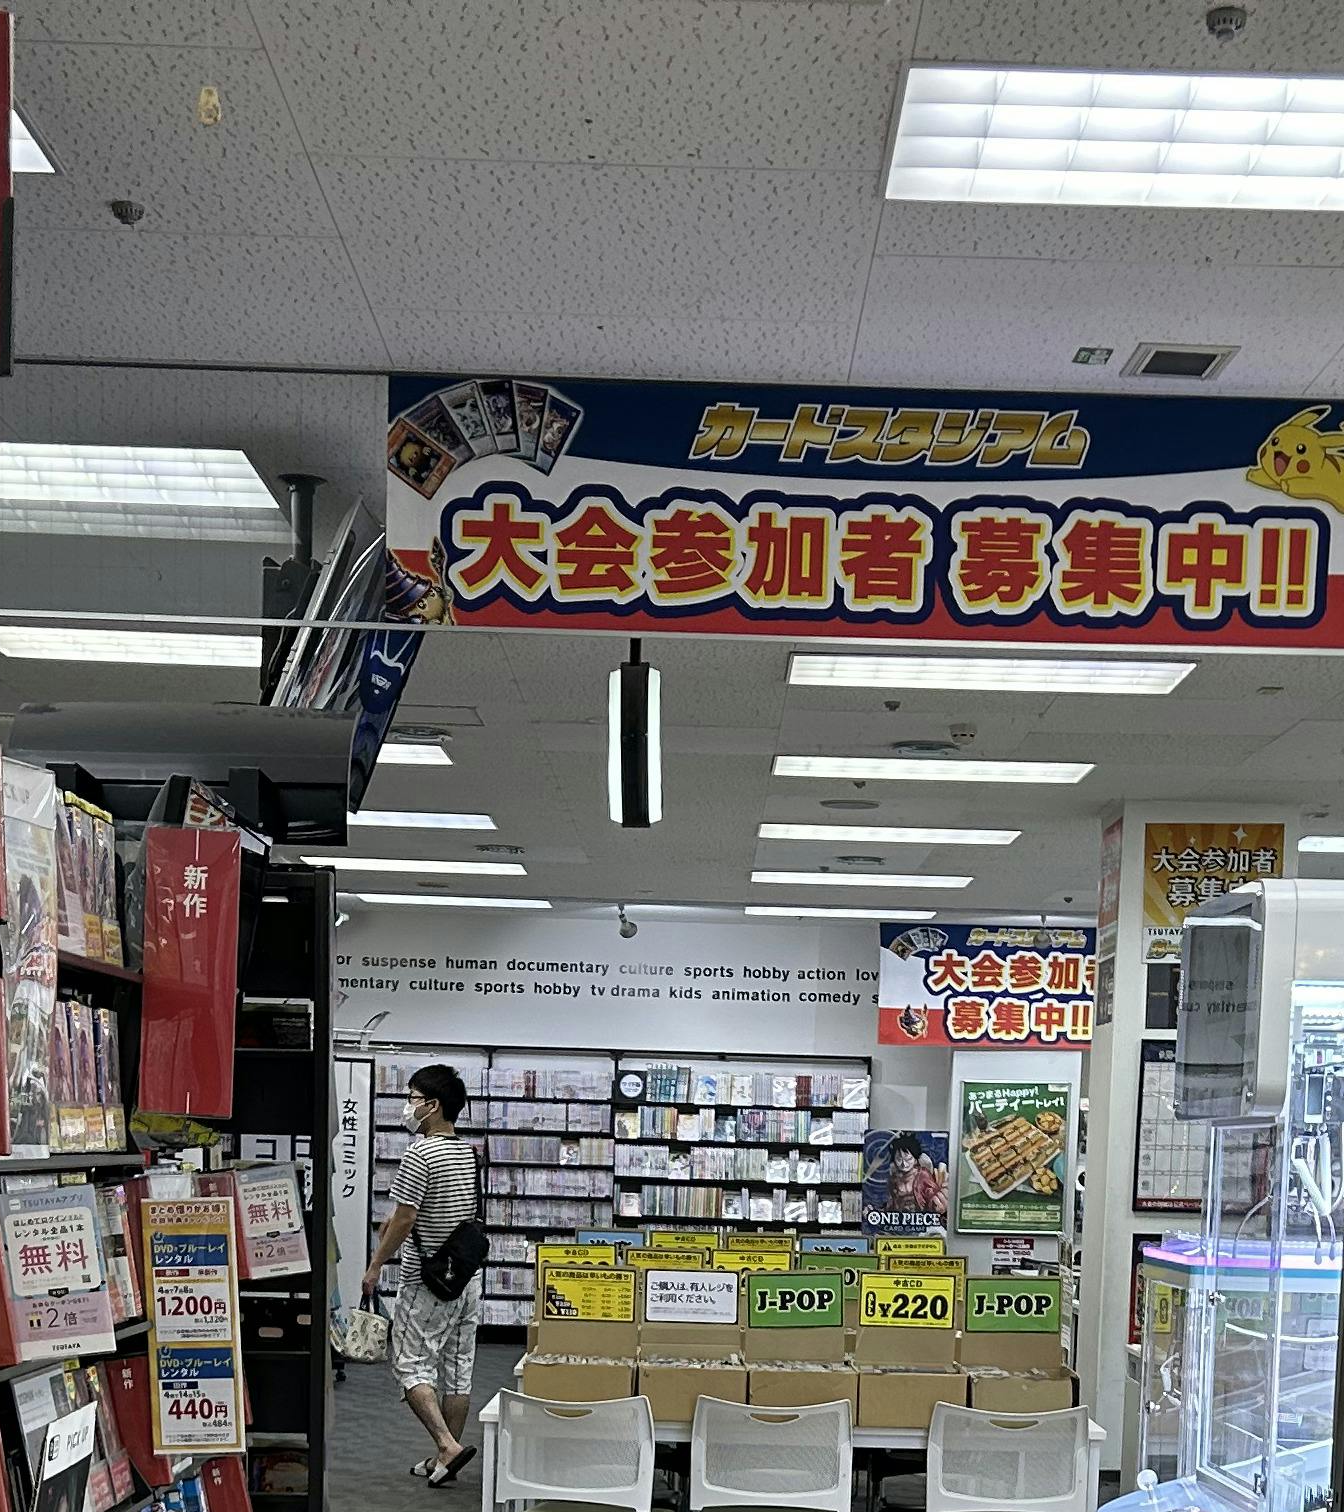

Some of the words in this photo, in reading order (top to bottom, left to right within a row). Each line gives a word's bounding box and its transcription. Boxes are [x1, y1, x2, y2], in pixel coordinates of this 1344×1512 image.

[689, 404, 1092, 469] カードスタジアム
[459, 501, 926, 605] 大会参加者
[957, 504, 1308, 610] 募集中!!
[1152, 848, 1277, 875] 大会参加者
[182, 864, 209, 919] 新作
[361, 955, 436, 970] suspense
[445, 956, 498, 970] human
[506, 958, 610, 977] documentary
[619, 961, 674, 976] culture
[683, 965, 734, 981] sports
[743, 966, 790, 983] hobby
[797, 967, 846, 981] action
[409, 977, 465, 992] culture
[474, 981, 525, 995] sports
[533, 982, 581, 998] hobby
[590, 984, 605, 997] tv
[611, 985, 660, 999] drama
[669, 985, 703, 1000] kids
[711, 987, 791, 1003] animation
[798, 990, 862, 1006] comedy
[952, 1000, 1091, 1037] 募集中!!
[968, 1086, 1040, 1101] あつまるHappy!
[342, 1098, 358, 1199] 女性コミック
[247, 1199, 293, 1226] 無料
[867, 1211, 900, 1226] ONE
[902, 1211, 941, 1226] PIECE
[19, 1238, 89, 1277] 無料
[155, 1254, 194, 1265] レンタル
[156, 1295, 227, 1317] 1,200円
[649, 1293, 716, 1305] ご利用ください。
[756, 1288, 834, 1312] J-POP
[878, 1294, 950, 1321] ¥220
[974, 1293, 1053, 1316] J-POP
[46, 1307, 78, 1330] 2倍
[161, 1368, 200, 1378] レンタル
[167, 1398, 229, 1421] 440円
